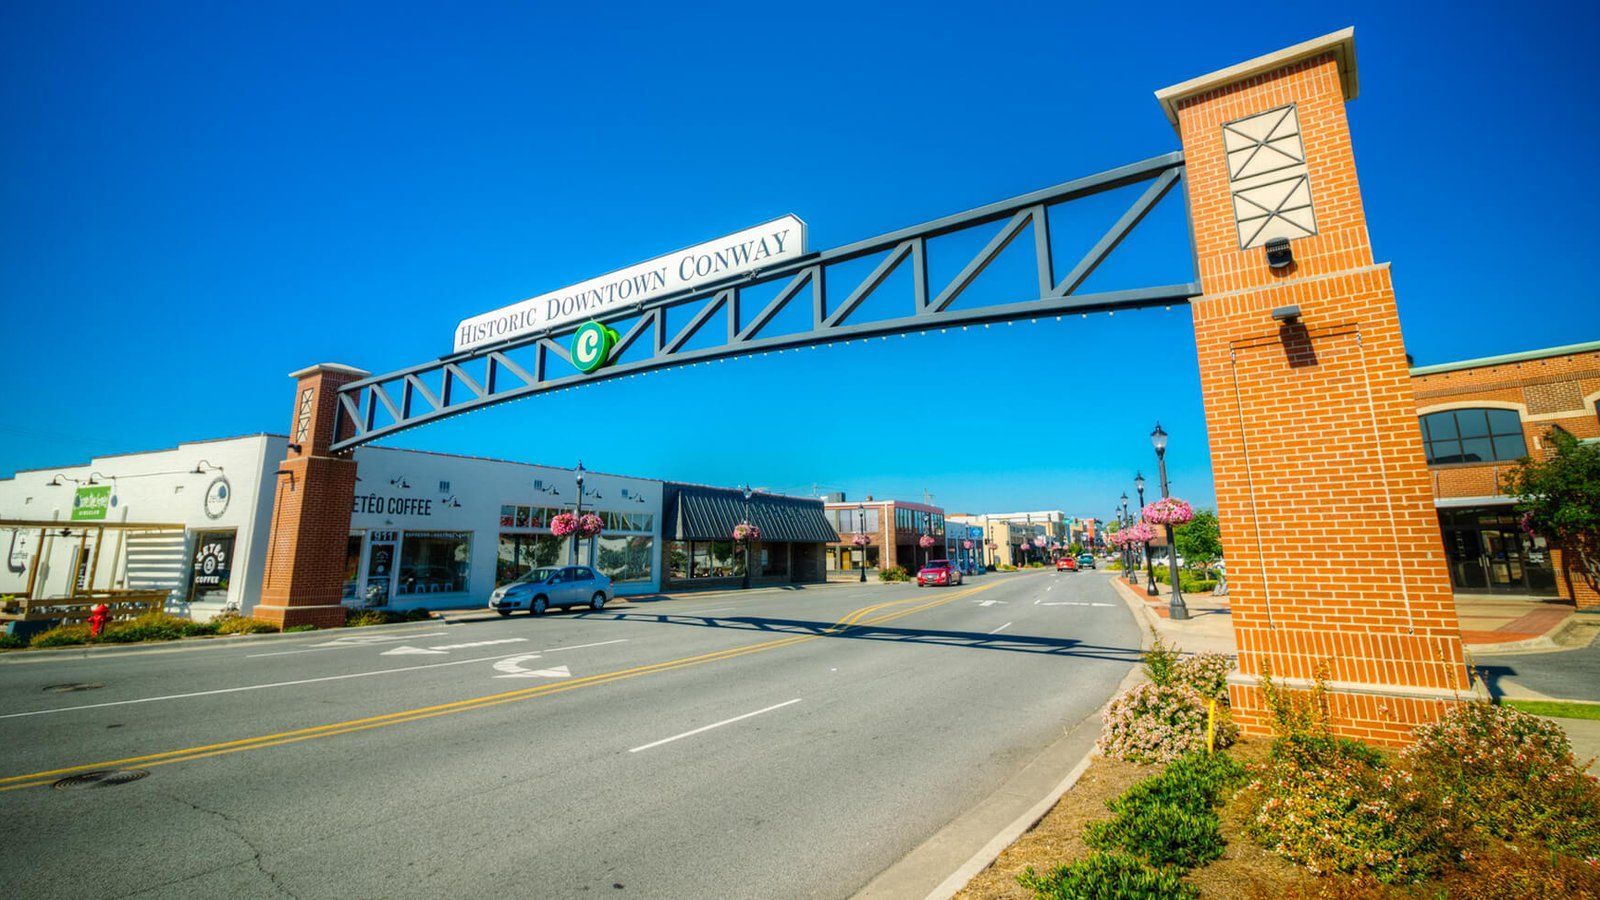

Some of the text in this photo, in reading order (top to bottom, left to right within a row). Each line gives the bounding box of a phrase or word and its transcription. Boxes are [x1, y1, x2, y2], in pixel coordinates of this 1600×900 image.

[459, 229, 789, 347] HISTORIC DOWNTOWN CONWAY
[576, 328, 598, 363] C
[352, 493, 432, 516] ETÊO COFFEE
[374, 531, 393, 541] 911
[195, 576, 220, 584] COFFEE
